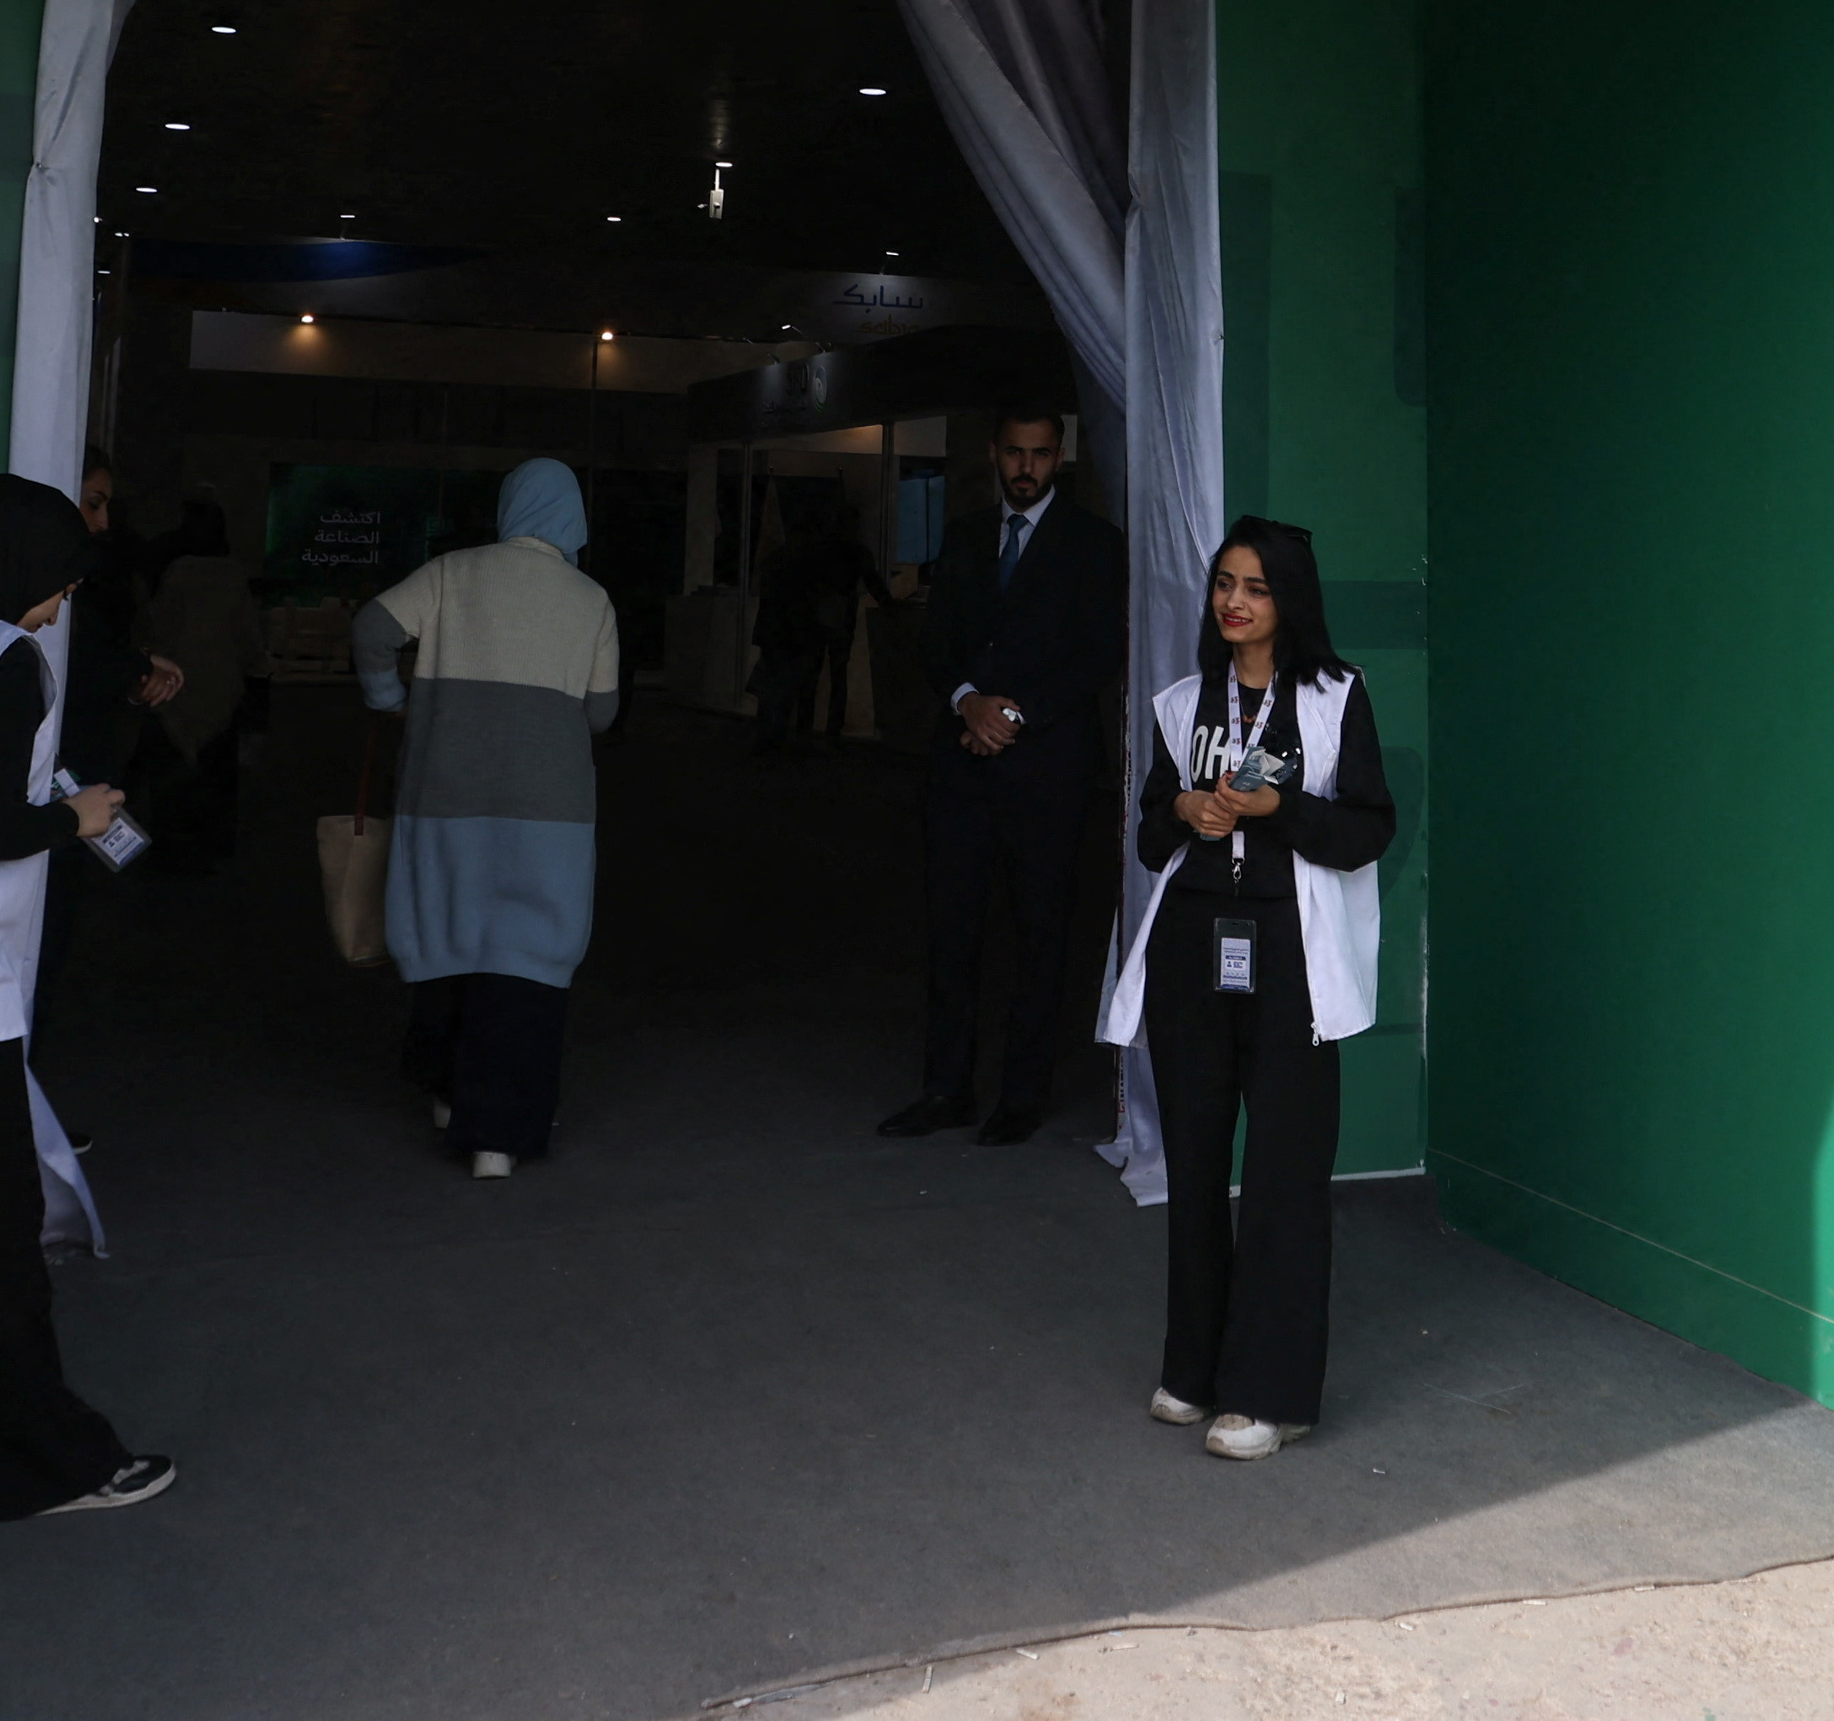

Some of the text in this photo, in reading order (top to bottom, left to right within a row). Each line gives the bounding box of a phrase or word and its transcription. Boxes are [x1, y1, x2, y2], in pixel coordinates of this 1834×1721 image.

[832, 284, 923, 314] سابك
[320, 509, 381, 525] اكتشف
[314, 529, 380, 545] الصناعة
[301, 548, 379, 567] السعودية
